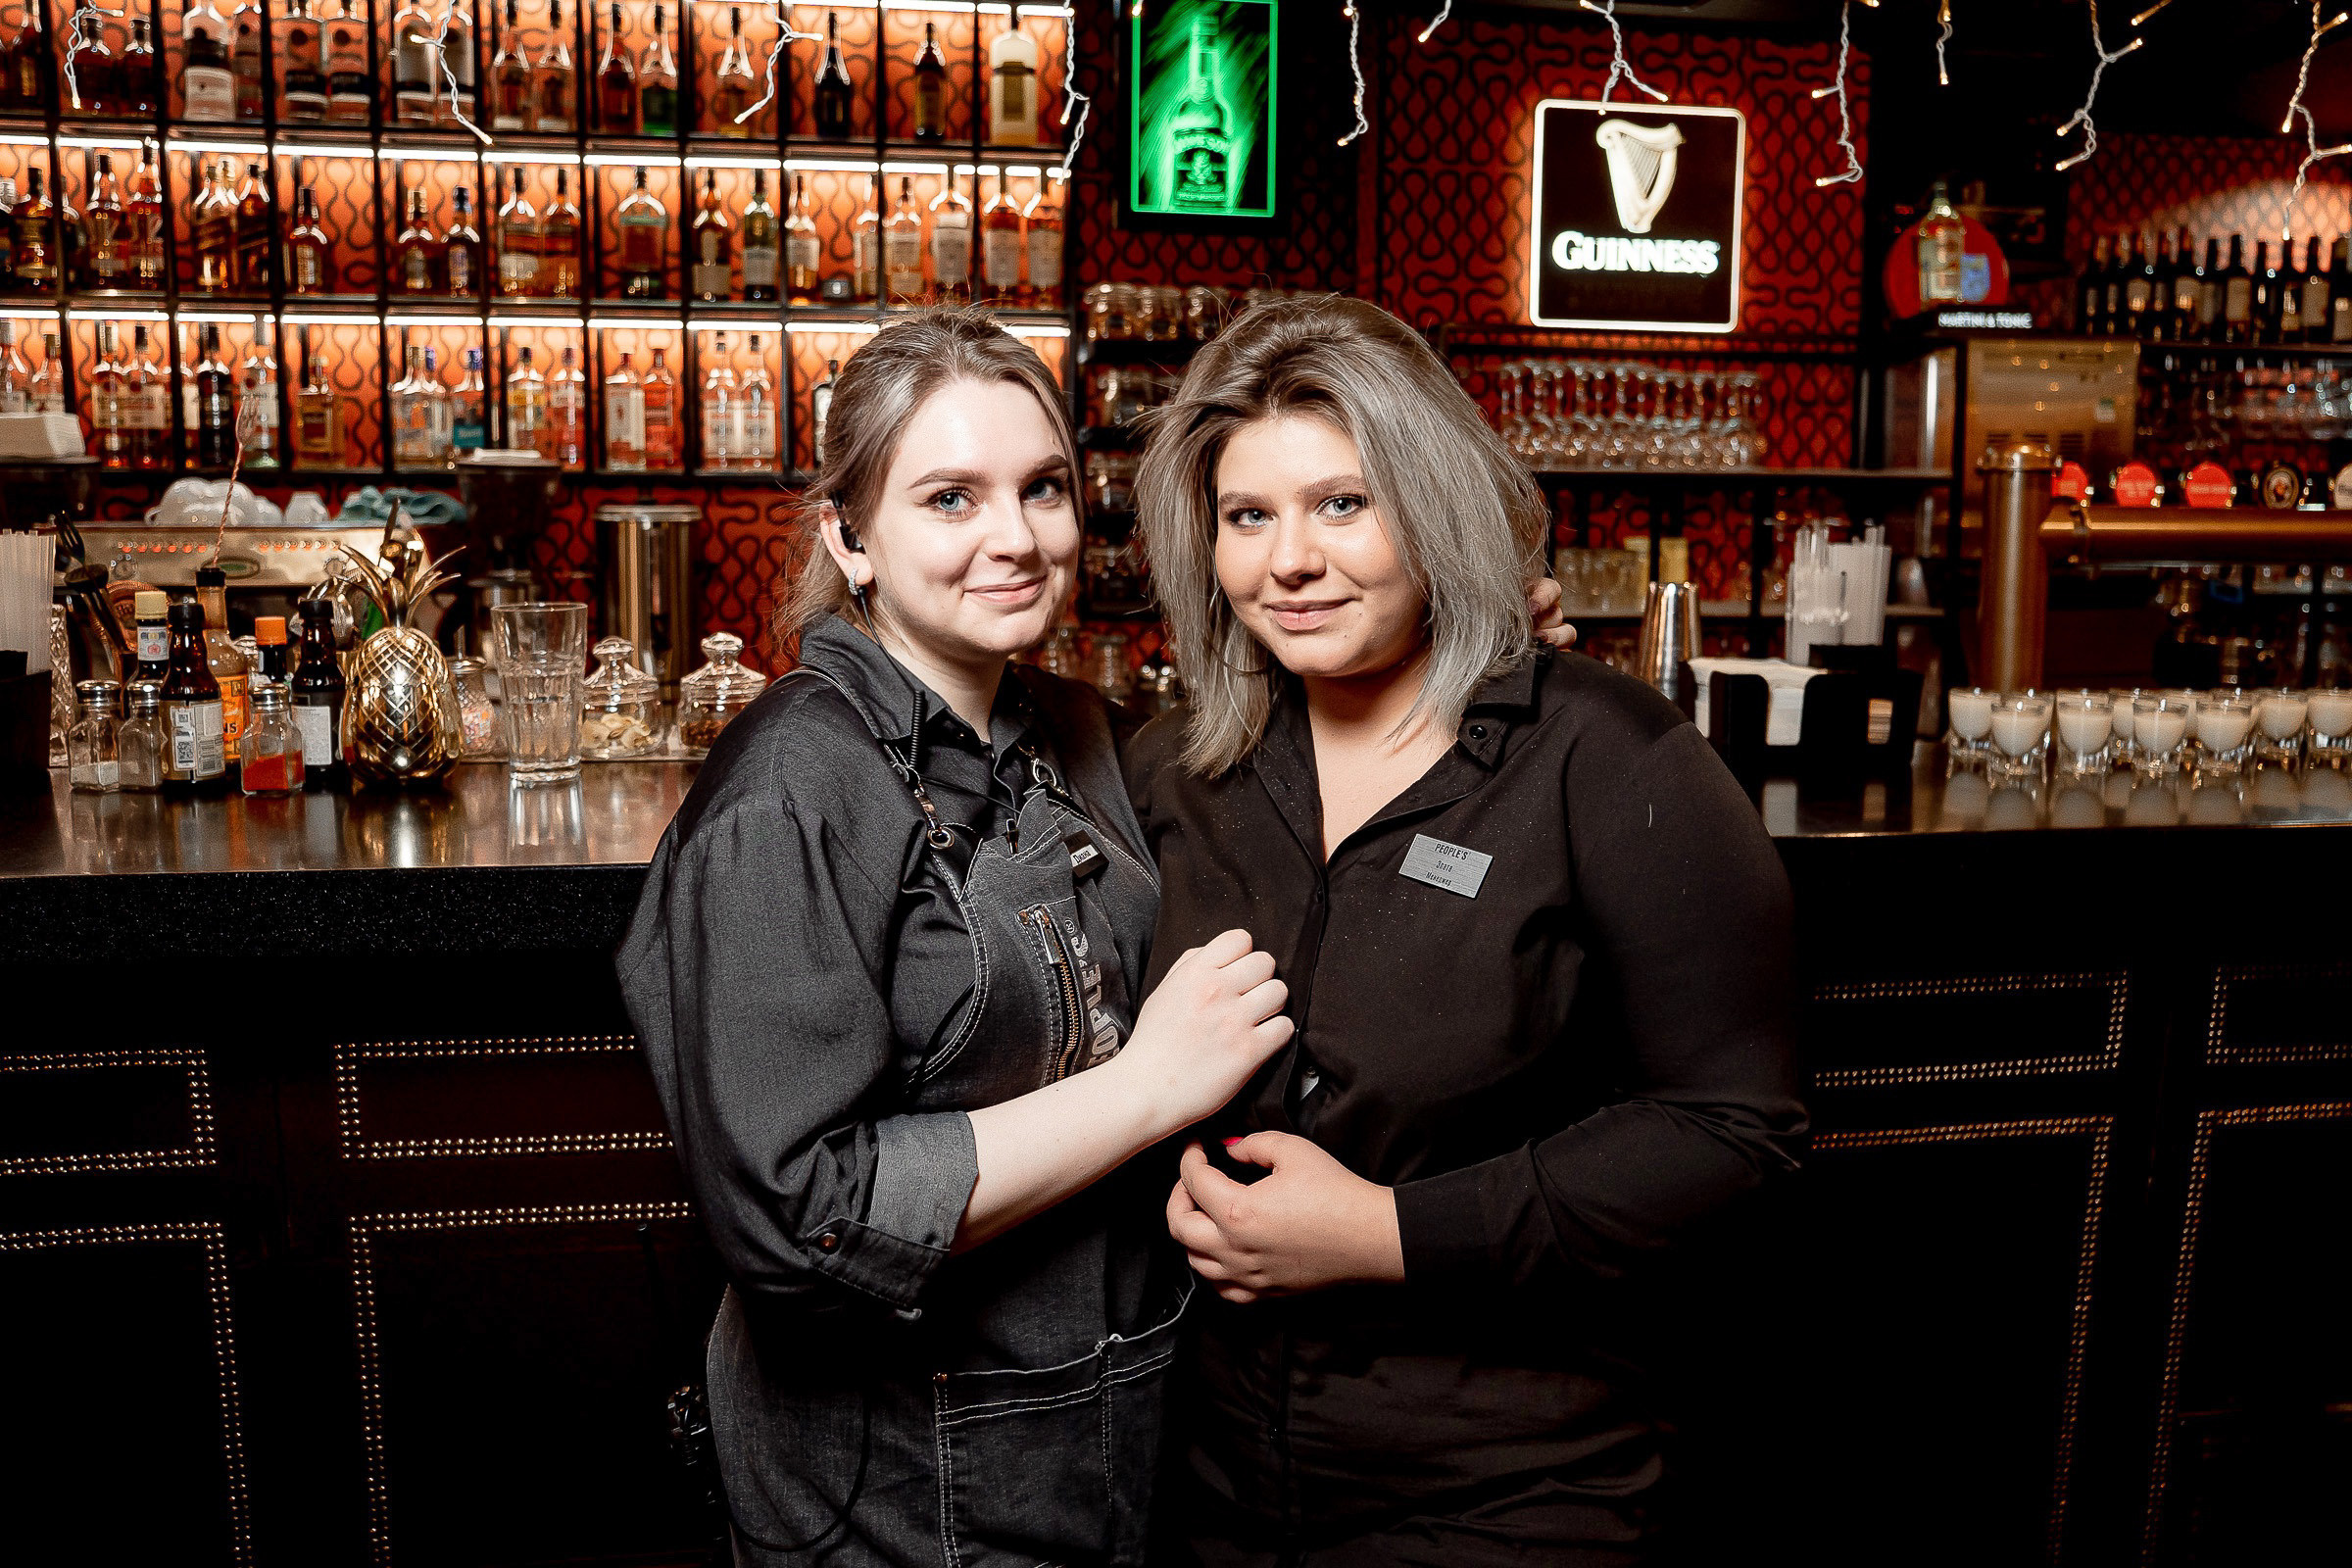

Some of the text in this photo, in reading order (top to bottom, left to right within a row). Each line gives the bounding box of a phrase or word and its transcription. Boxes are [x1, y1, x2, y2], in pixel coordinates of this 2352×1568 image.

[1552, 231, 1720, 273] GUINNESS
[1435, 843, 1468, 859] PEOPLE'S
[1071, 933, 1120, 1068] EOPLE'S
